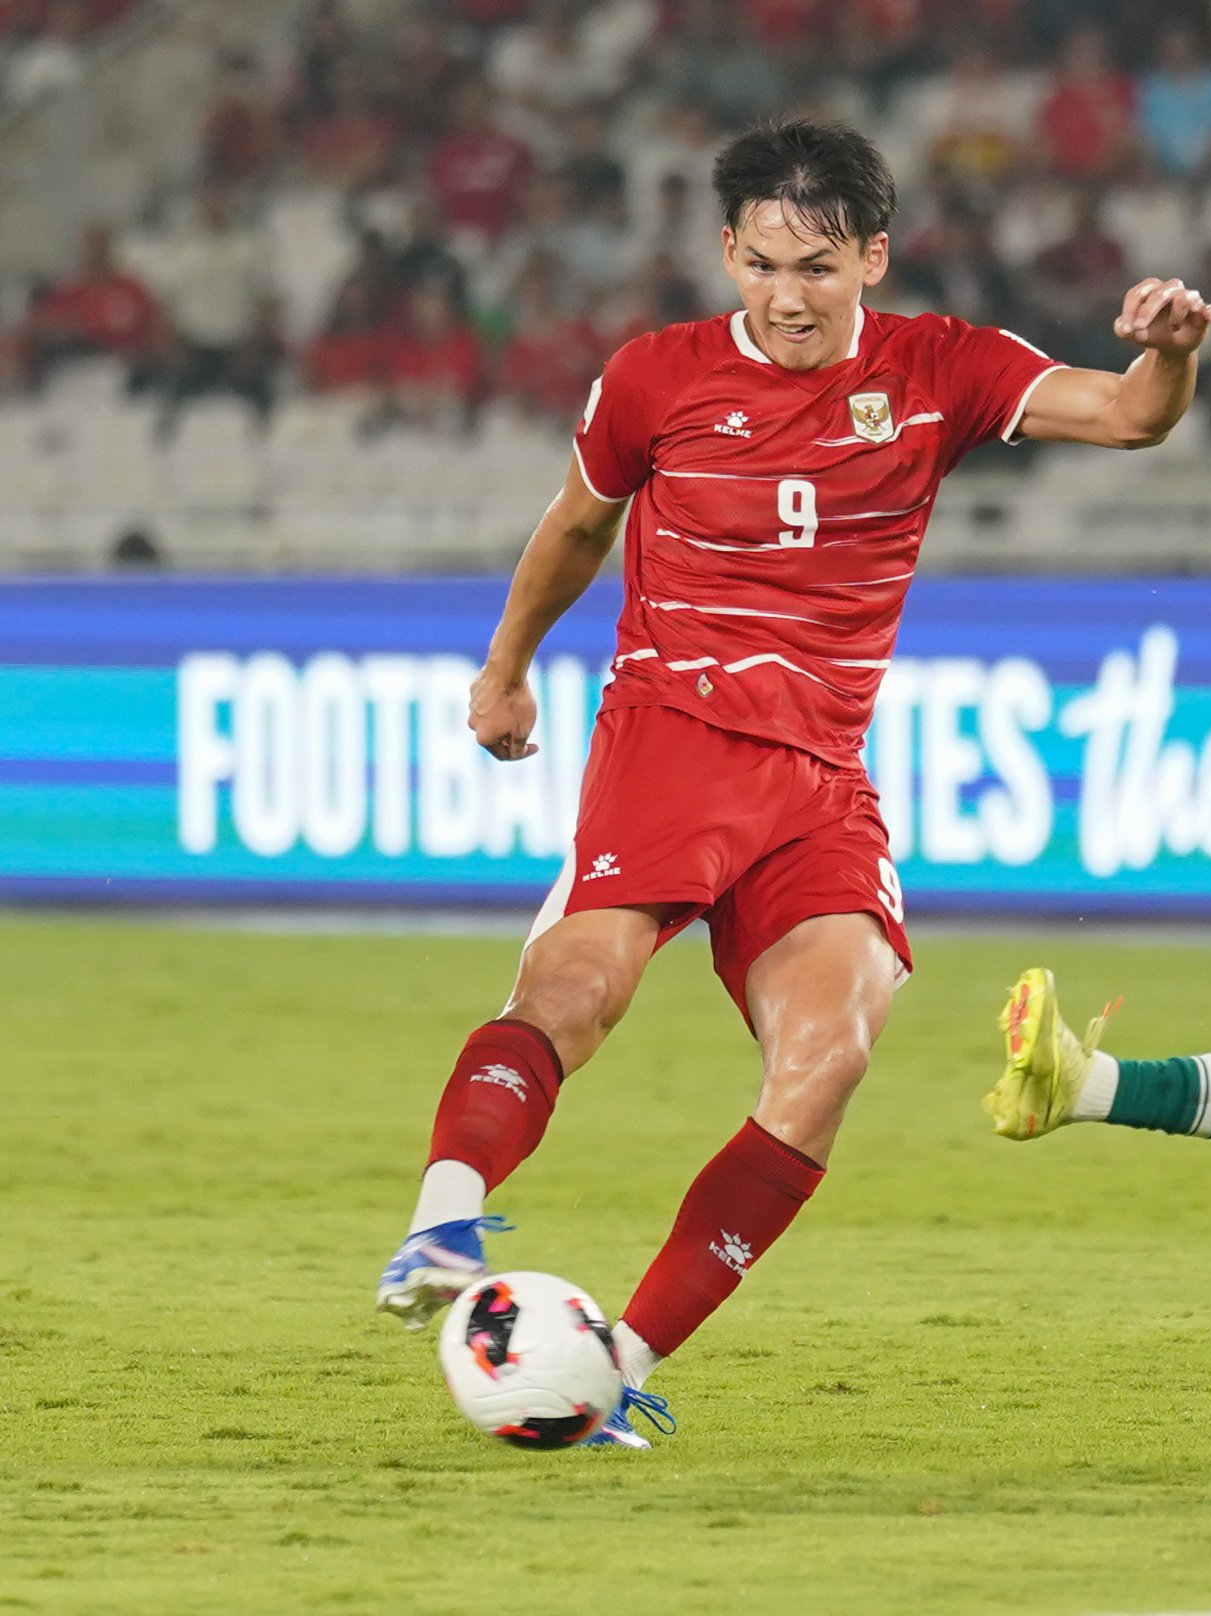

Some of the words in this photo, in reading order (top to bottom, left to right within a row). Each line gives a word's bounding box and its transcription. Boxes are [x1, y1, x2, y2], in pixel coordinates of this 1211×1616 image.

[714, 423, 752, 439] KELME
[776, 480, 818, 548] 9
[176, 650, 612, 858] FOOTBAL
[582, 867, 622, 882] KELME
[877, 857, 904, 924] 9
